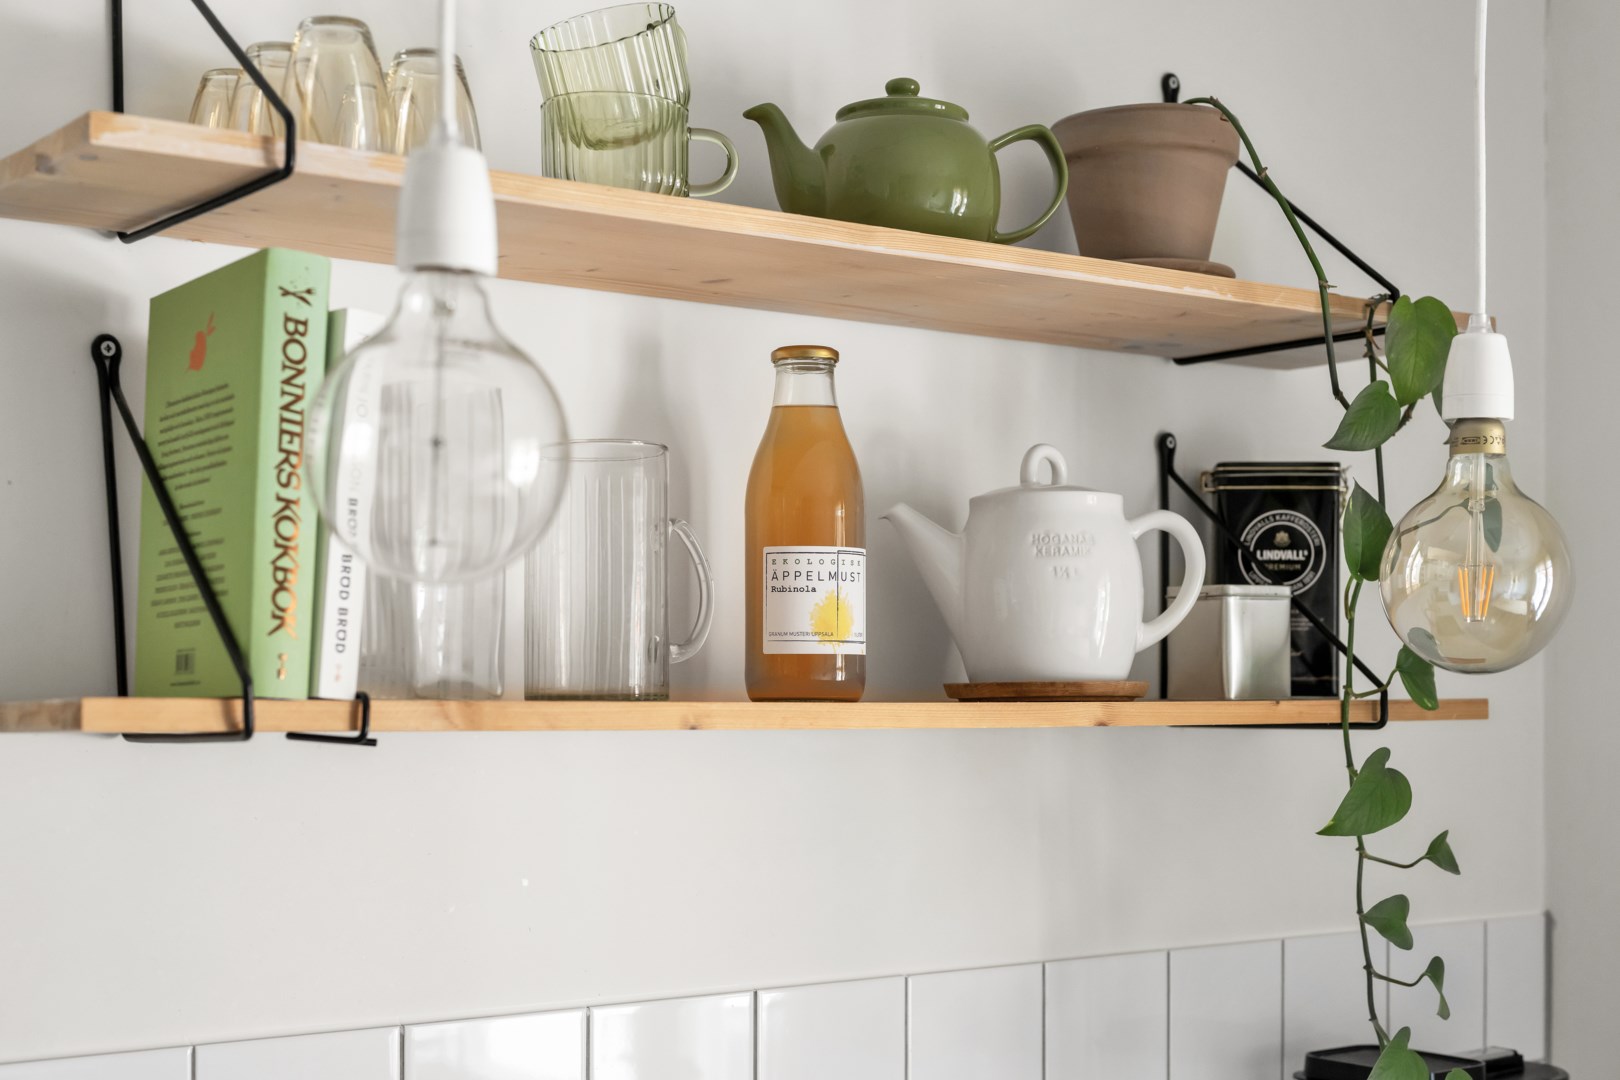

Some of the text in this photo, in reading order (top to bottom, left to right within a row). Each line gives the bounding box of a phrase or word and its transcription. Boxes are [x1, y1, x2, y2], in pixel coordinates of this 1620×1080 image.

[267, 312, 309, 641] BONNIERS KOKBOK
[771, 569, 861, 583] ÄPPELMUST
[771, 585, 817, 593] Rubinola
